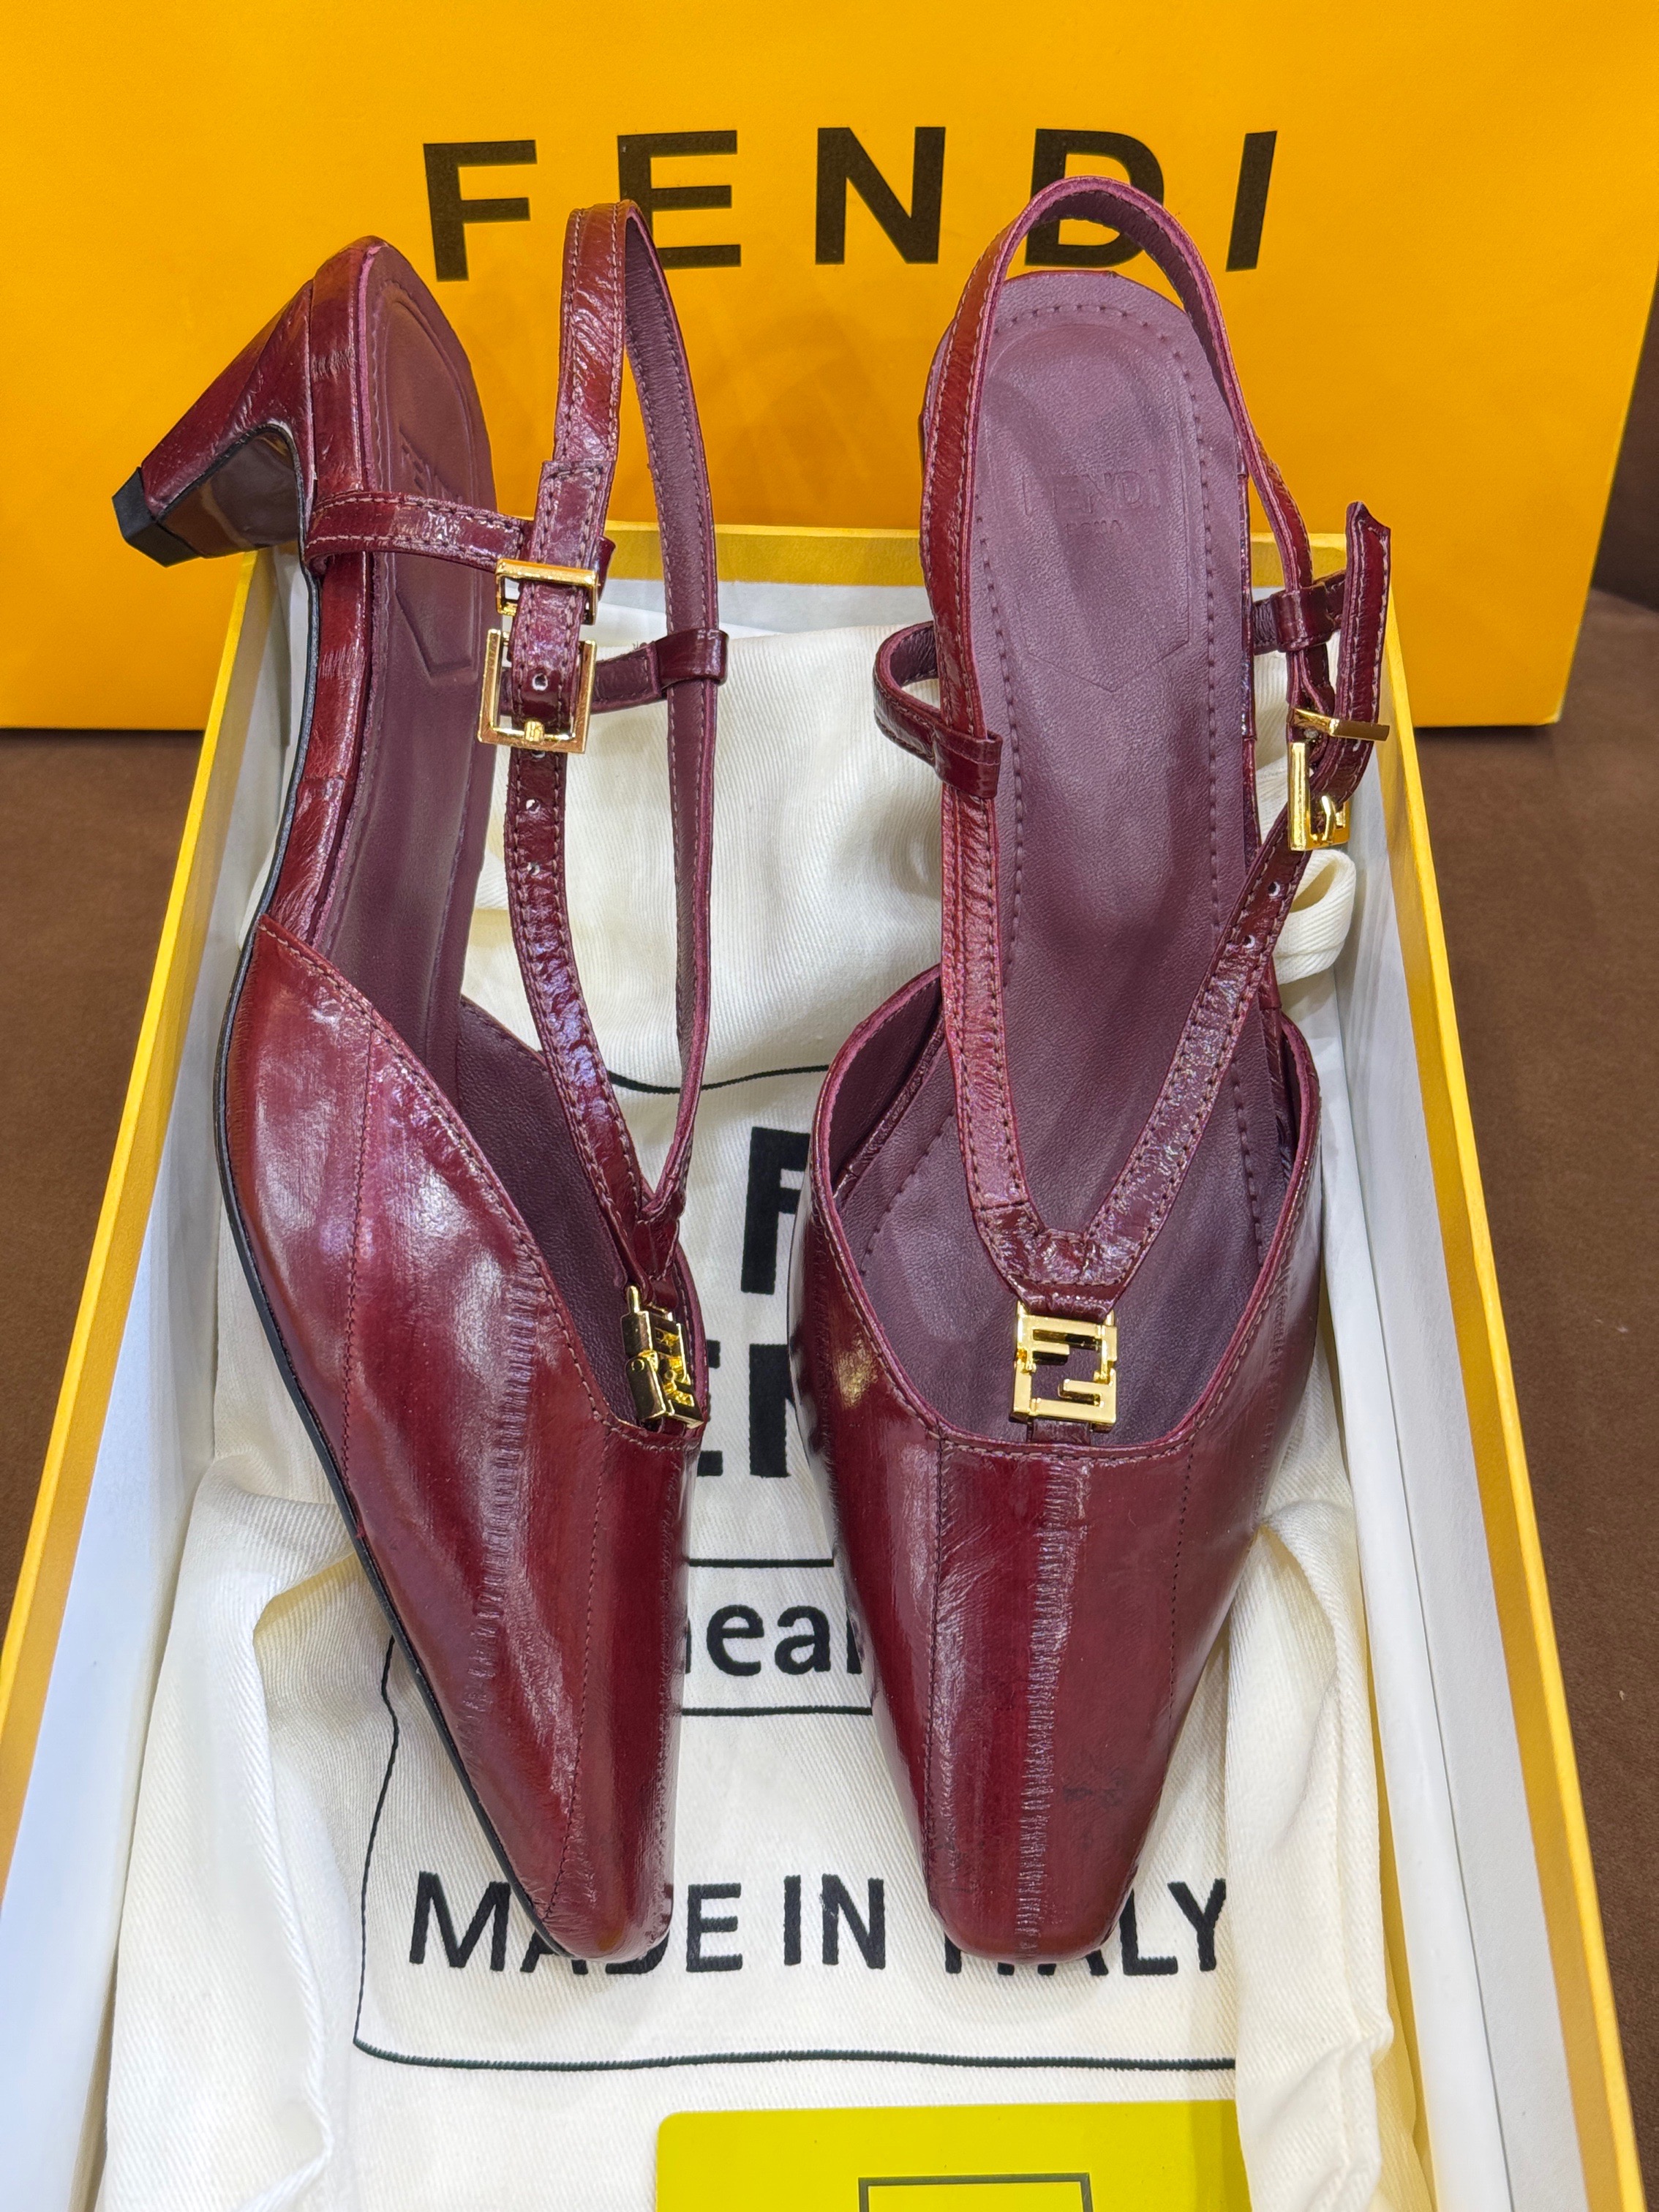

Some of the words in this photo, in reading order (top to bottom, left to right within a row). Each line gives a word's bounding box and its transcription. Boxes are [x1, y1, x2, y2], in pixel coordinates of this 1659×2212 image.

[423, 127, 1278, 282] FENDI
[410, 1870, 743, 1975] ME
[783, 1874, 887, 1969] IN
